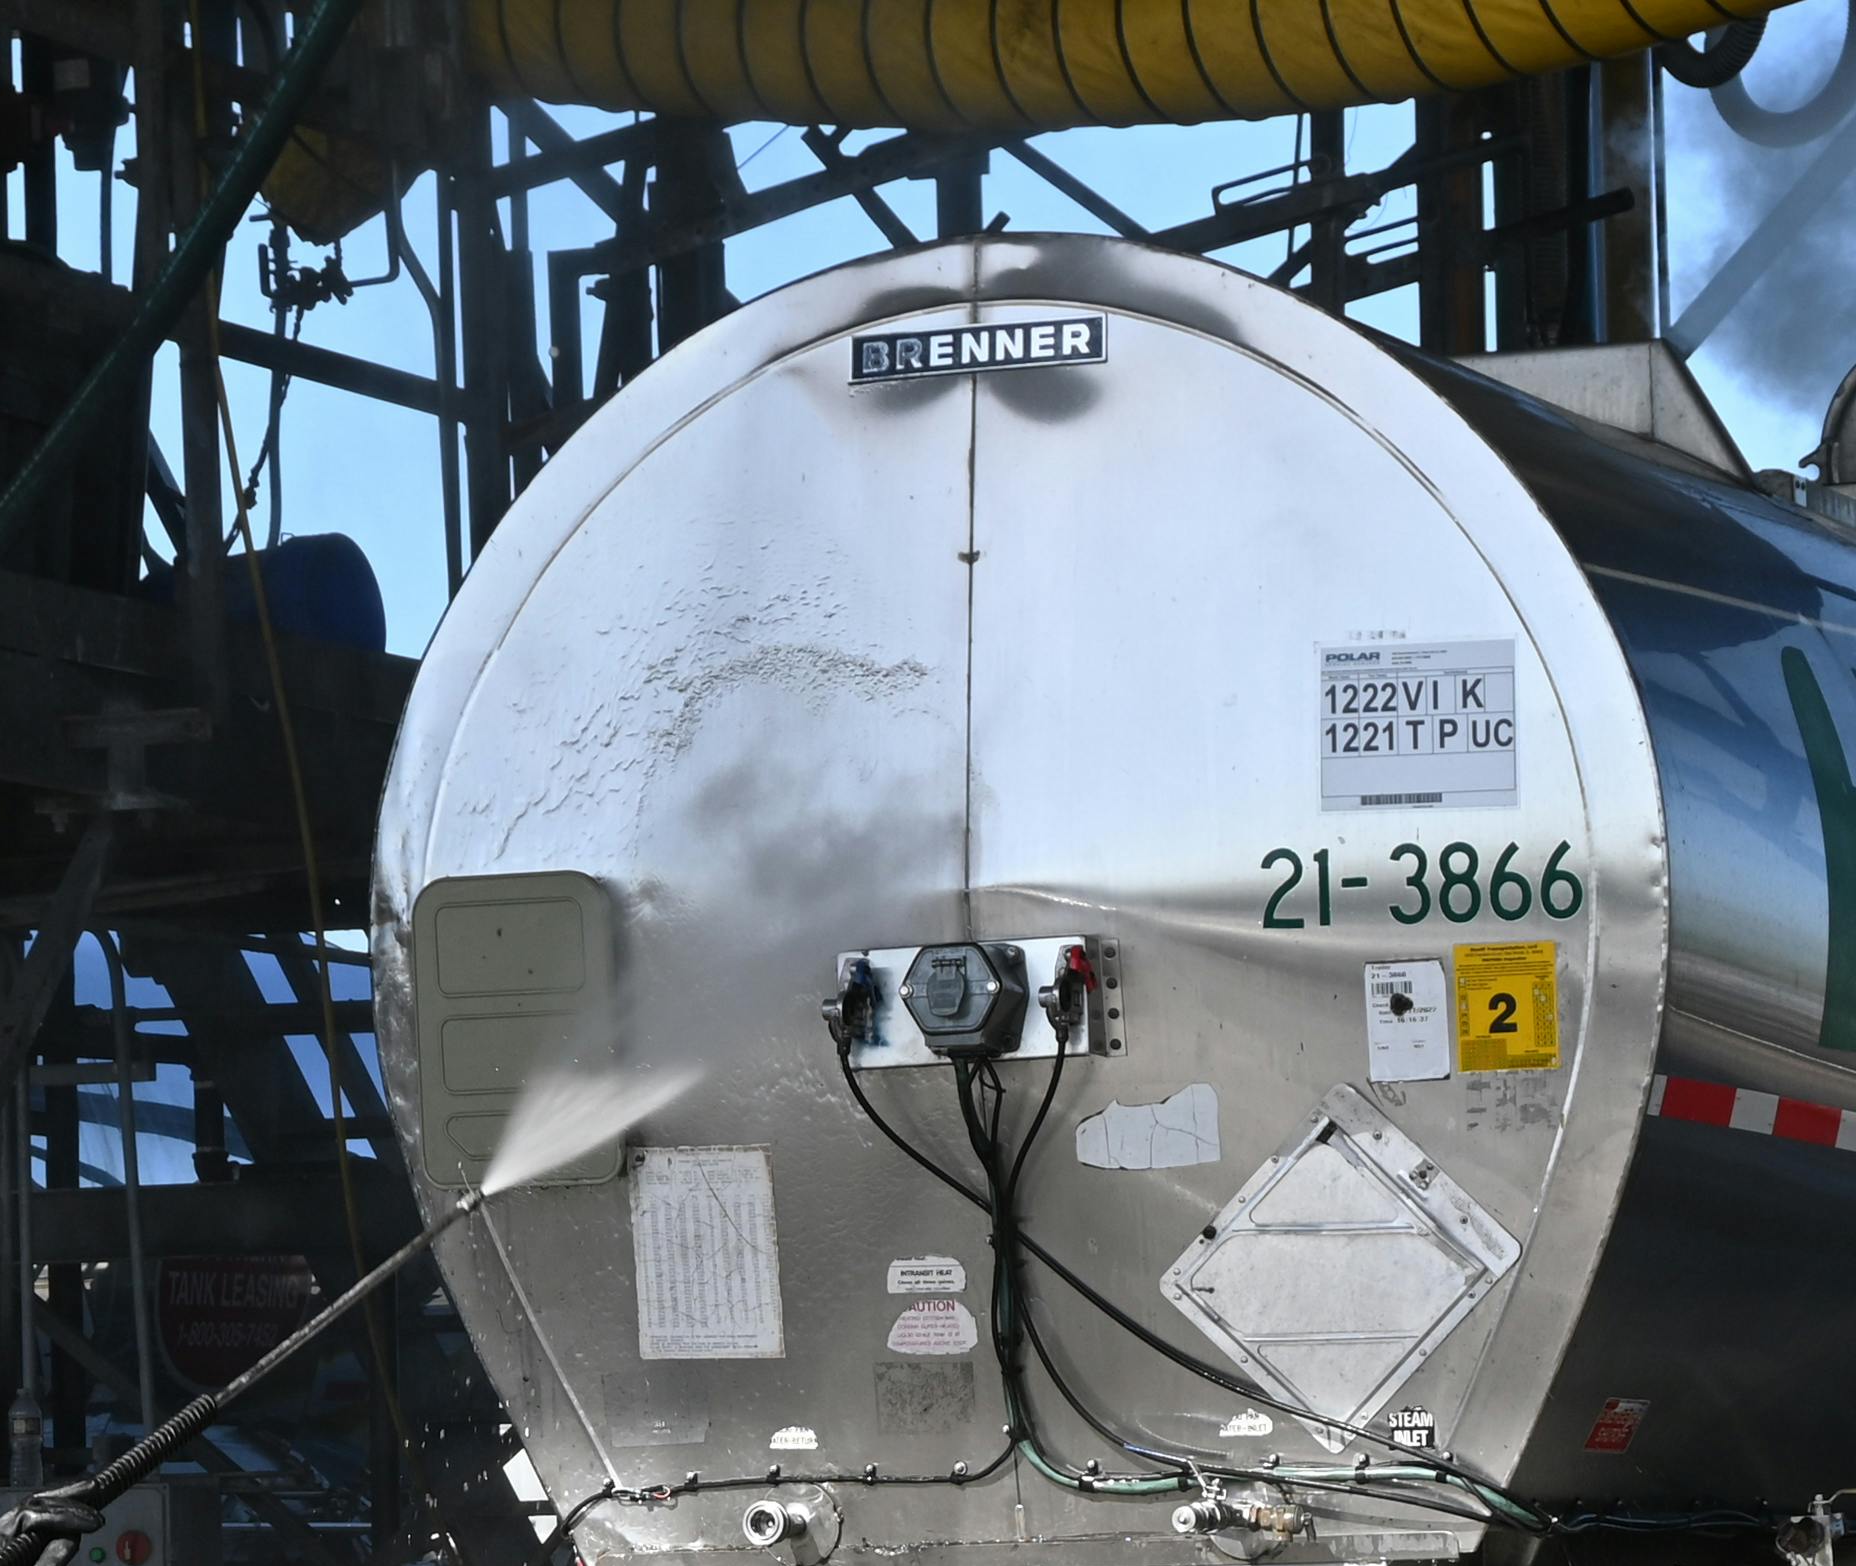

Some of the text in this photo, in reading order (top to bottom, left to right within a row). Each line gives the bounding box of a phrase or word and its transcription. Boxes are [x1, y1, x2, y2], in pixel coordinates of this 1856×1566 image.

[861, 322, 1092, 375] BRENNER
[1324, 651, 1381, 664] POLAR
[1461, 678, 1485, 709] K
[1471, 718, 1514, 749] UC
[1260, 838, 1584, 929] 21-3866
[1487, 992, 1519, 1034] 2
[167, 1270, 299, 1310] TANK LEASING
[910, 1299, 956, 1312] AUTION
[1388, 1411, 1434, 1428] STEAM
[1393, 1429, 1429, 1447] INLET
